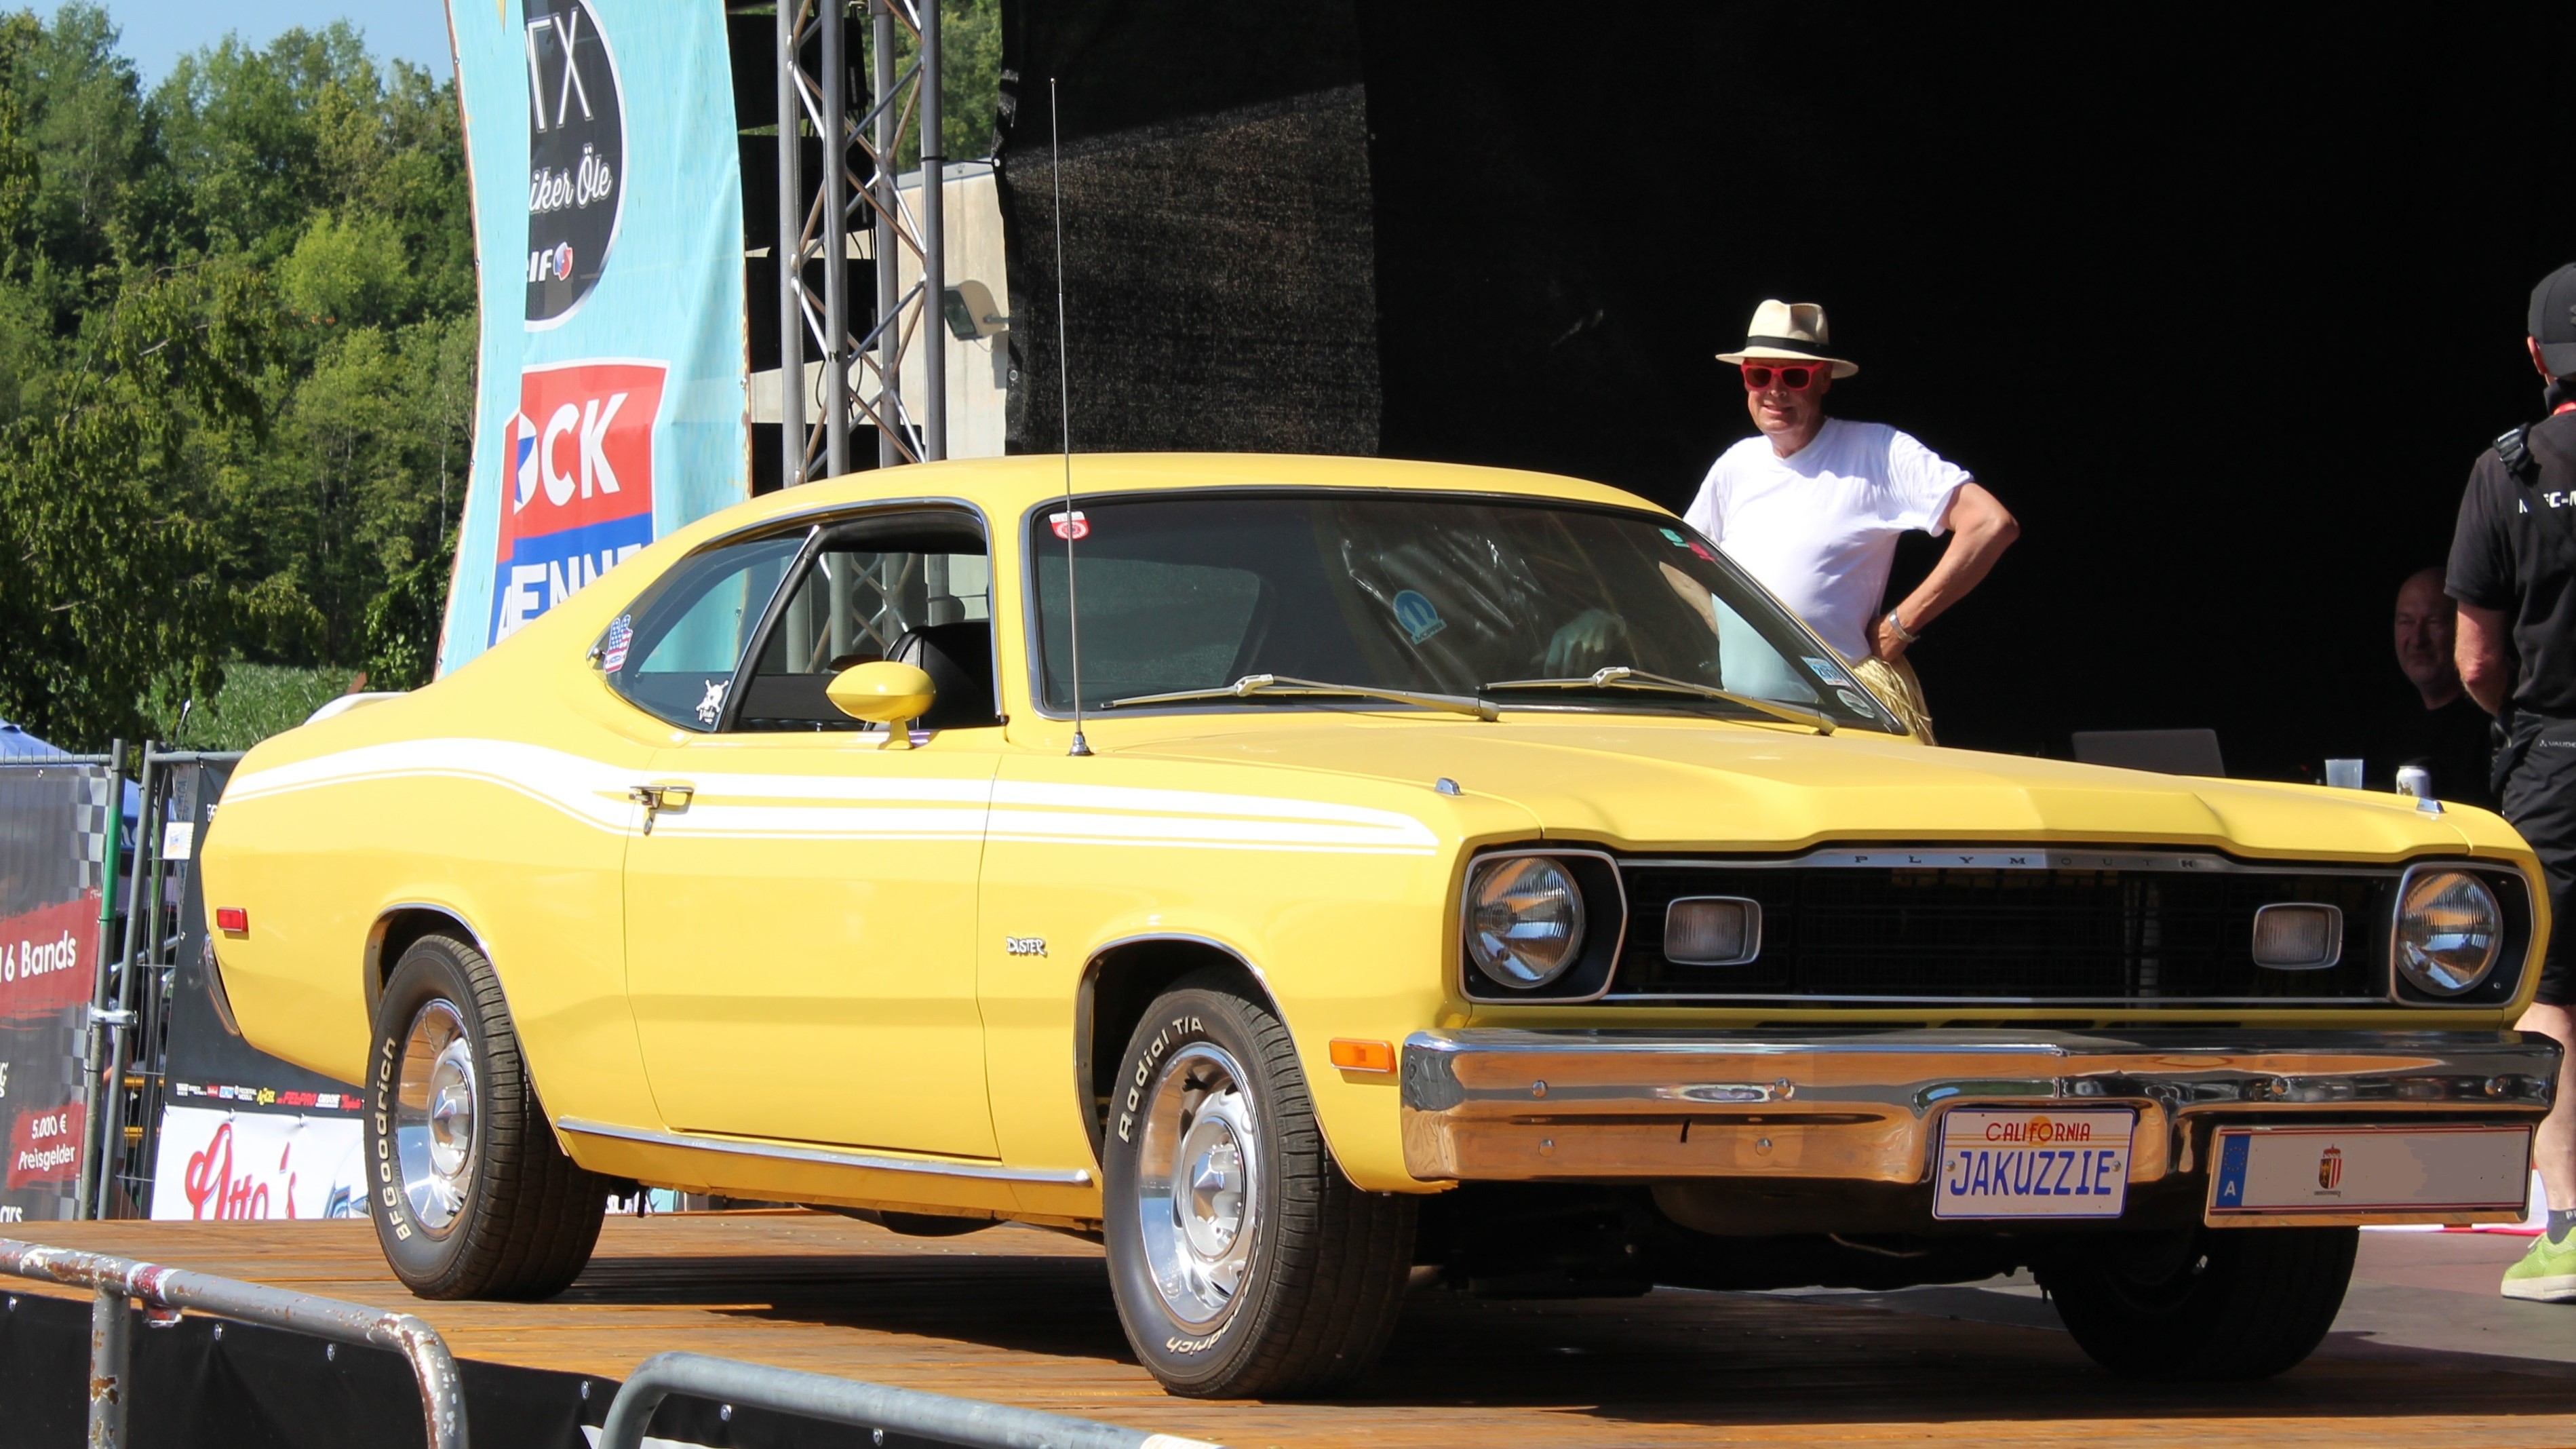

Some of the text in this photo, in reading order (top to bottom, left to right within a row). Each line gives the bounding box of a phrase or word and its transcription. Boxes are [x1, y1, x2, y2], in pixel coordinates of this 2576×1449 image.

[577, 146, 612, 206] Öle
[1854, 853, 2194, 870] PLYMOUTH
[21, 929, 77, 979] Bands
[1118, 1016, 1205, 1144] Radial T/A
[32, 1113, 67, 1140] 5.000 €
[375, 1036, 412, 1241] BFGoodrich
[1986, 1122, 2091, 1142] CALIFORNIA
[18, 1143, 76, 1172] Preisgelder
[1950, 1150, 2115, 1197] JAKUZZIE
[2223, 1180, 2237, 1197] A
